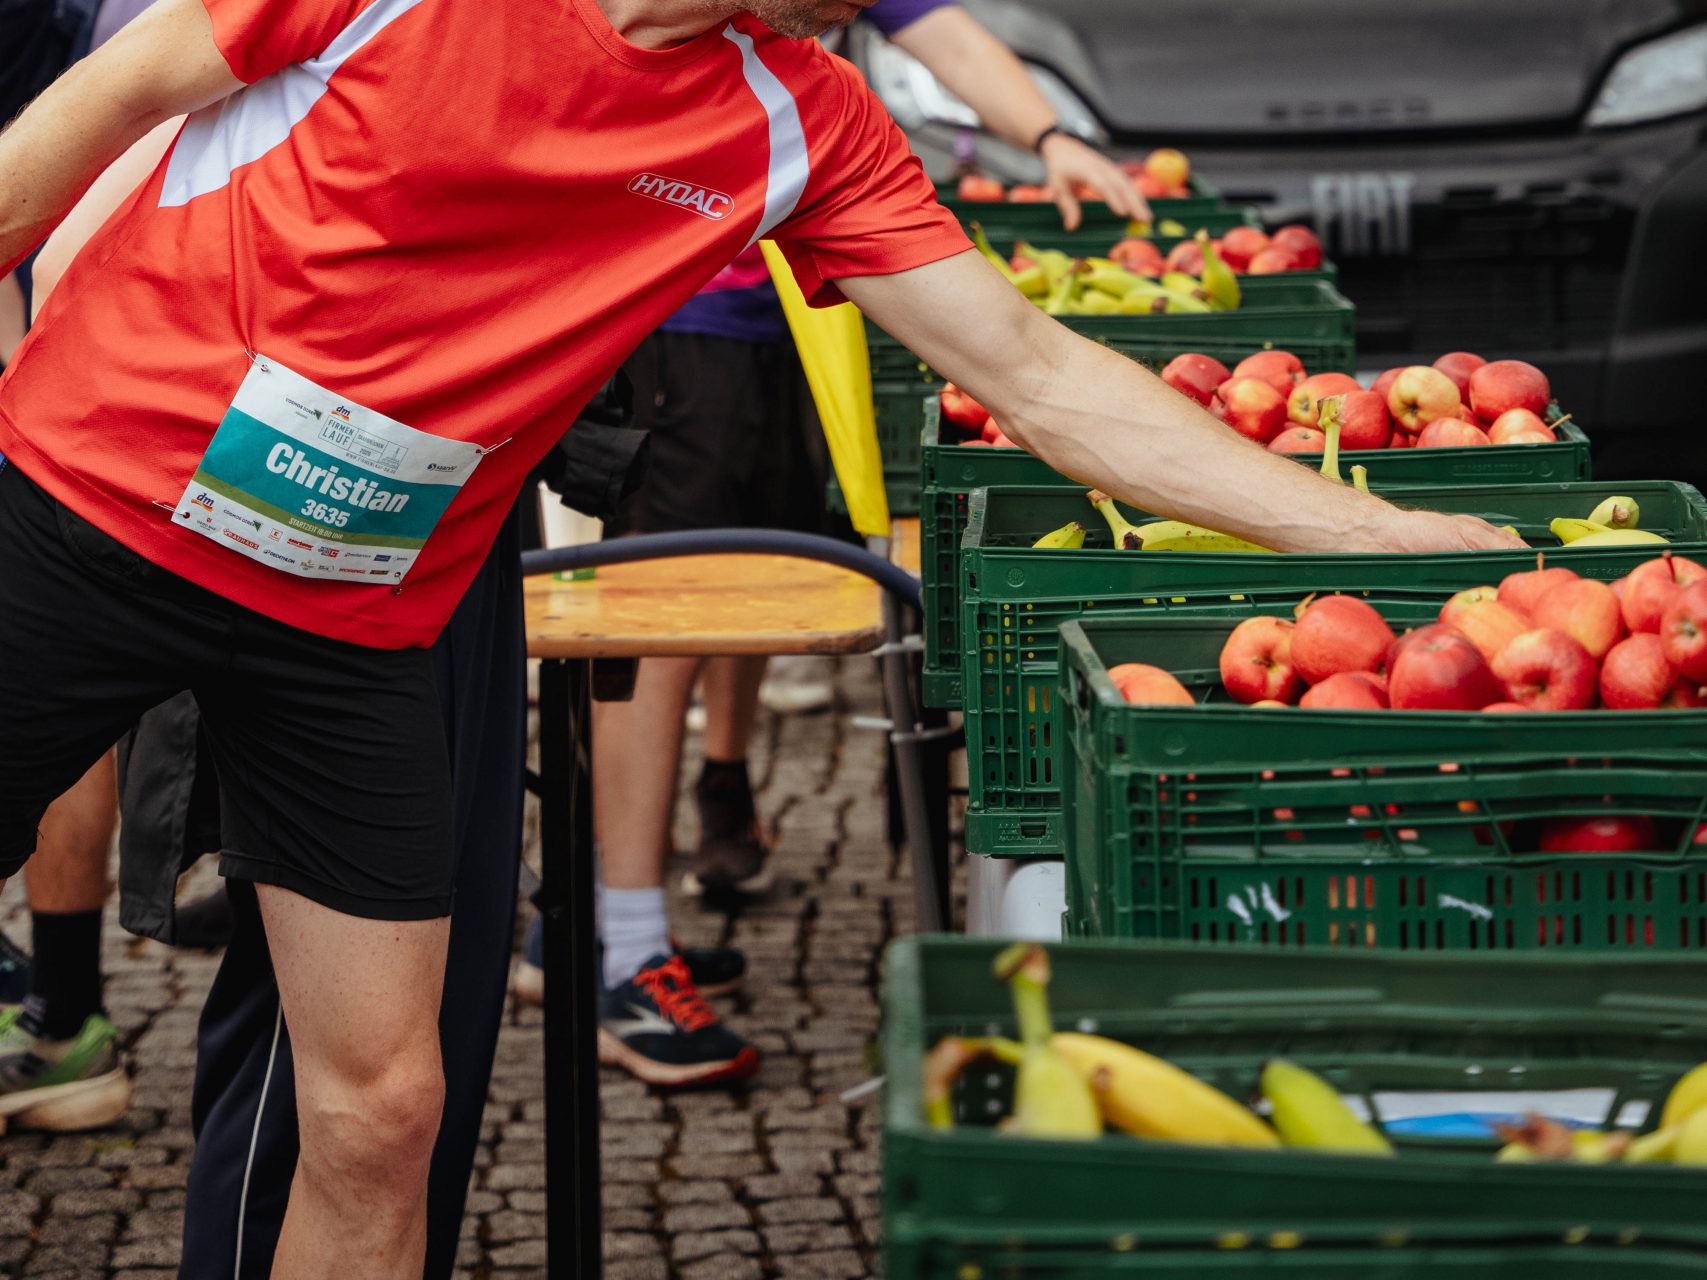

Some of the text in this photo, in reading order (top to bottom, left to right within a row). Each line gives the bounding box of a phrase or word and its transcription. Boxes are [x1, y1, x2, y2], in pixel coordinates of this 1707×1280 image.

[632, 175, 728, 218] HYDAC
[1310, 171, 1412, 256] FIAT
[336, 405, 351, 416] dm
[322, 427, 351, 445] LAUF
[328, 419, 355, 435] FIRMEN
[266, 442, 410, 513] Christian
[196, 492, 215, 507] dm
[301, 499, 350, 528] 3635
[289, 518, 318, 535] STARTZEIT
